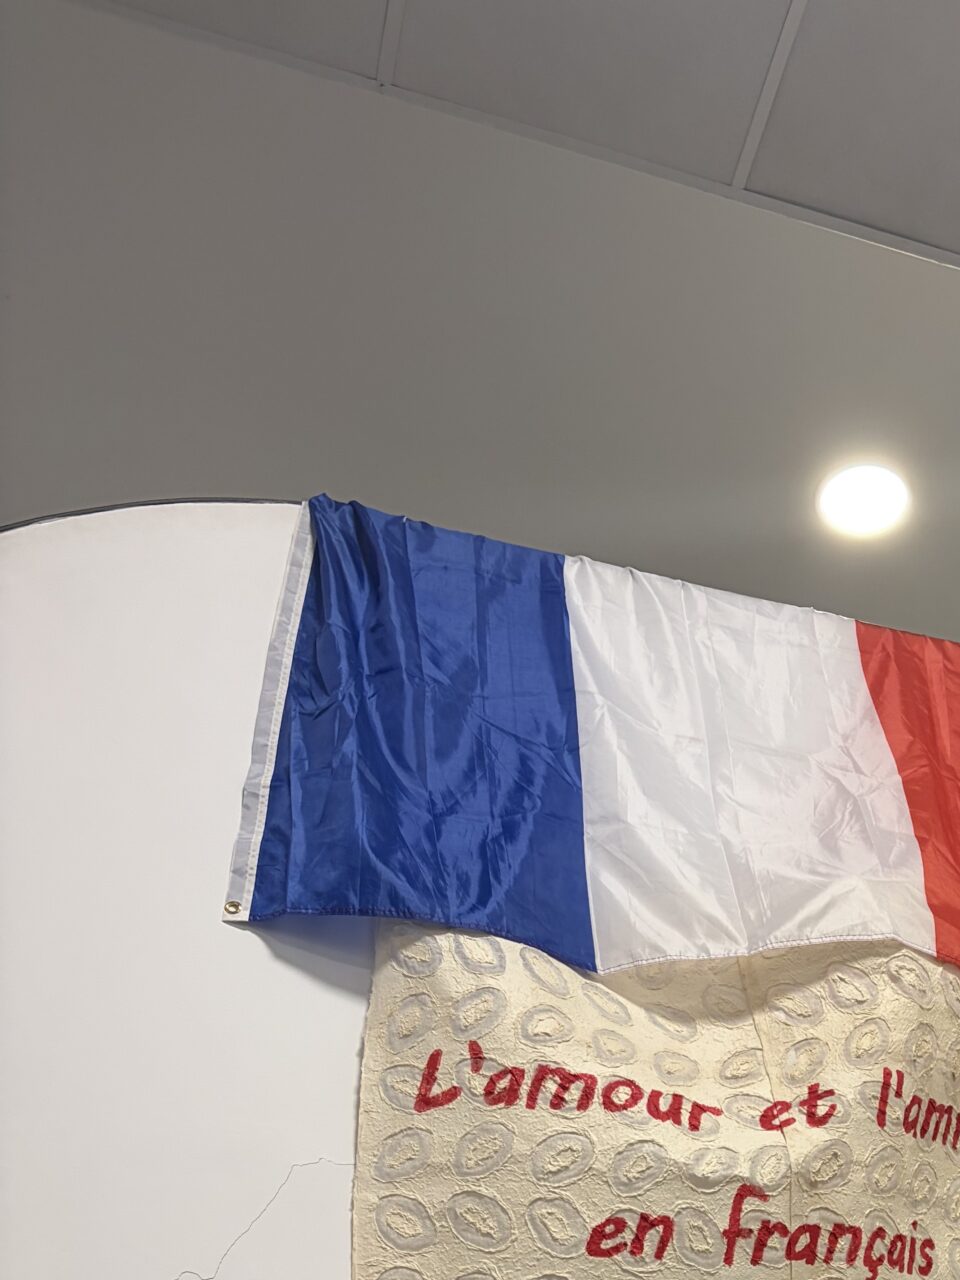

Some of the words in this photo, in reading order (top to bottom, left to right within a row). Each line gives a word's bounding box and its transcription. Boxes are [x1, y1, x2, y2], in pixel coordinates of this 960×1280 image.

[413, 1039, 723, 1132] L'amour
[758, 1082, 838, 1132] et
[585, 1211, 674, 1261] en
